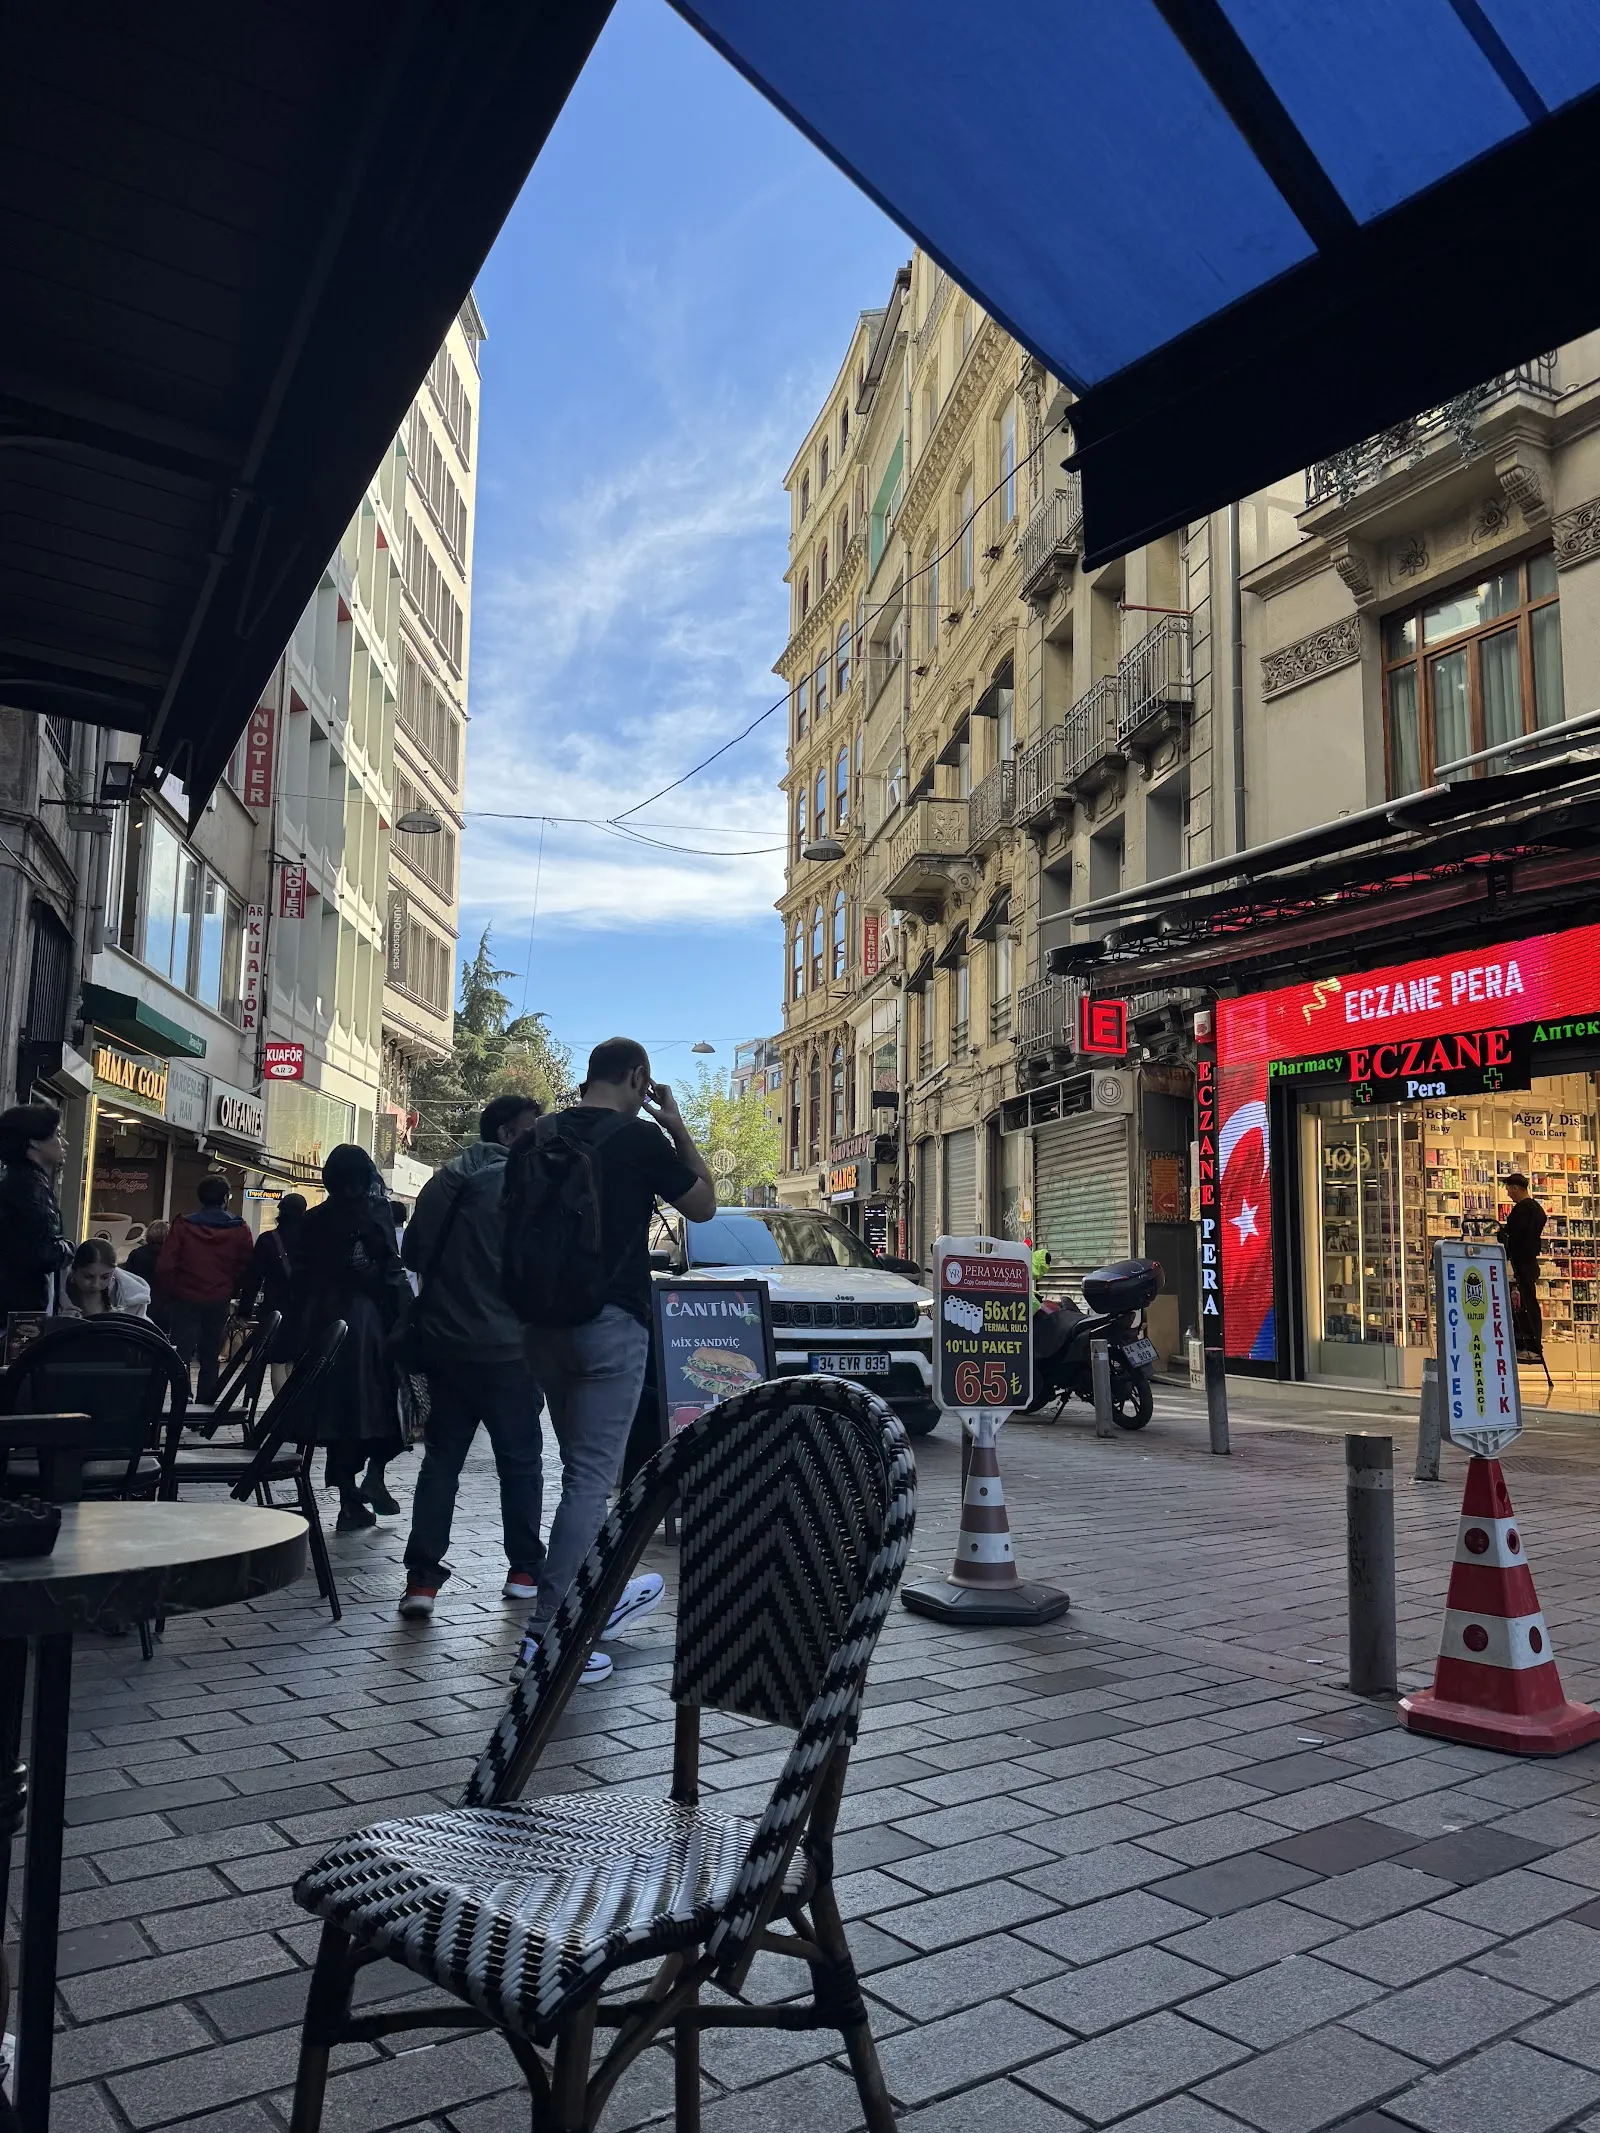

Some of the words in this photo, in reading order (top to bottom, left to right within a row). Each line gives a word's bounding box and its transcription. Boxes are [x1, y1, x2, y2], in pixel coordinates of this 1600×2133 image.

[250, 713, 268, 803] NOTER
[286, 867, 301, 917] NOTER
[248, 906, 263, 917] AR
[243, 922, 261, 1028] KUAFÖR
[1343, 976, 1442, 1022] ECZANE
[1451, 959, 1525, 1006] PERA
[266, 1047, 303, 1062] KUAFÖR
[1348, 1029, 1512, 1082] ECZANE
[275, 1066, 286, 1074] AR
[1268, 1055, 1343, 1079] Pharmacy
[1407, 1079, 1447, 1099] Pera
[1425, 1108, 1467, 1121] Bebek
[1514, 1112, 1543, 1124] Ağız
[1198, 1061, 1214, 1205] ECZANE
[1529, 1128, 1546, 1136] Oral
[1549, 1130, 1567, 1138] Care
[830, 1164, 857, 1192] CHANGE
[964, 1264, 990, 1277] PERA
[992, 1266, 1023, 1281] YAŞAR
[1202, 1218, 1219, 1315] PERA
[665, 1300, 754, 1317] CANTİNE
[984, 1300, 1026, 1321] 56x12
[984, 1322, 1010, 1333] TERMAL
[1010, 1323, 1028, 1333] RULO
[671, 1336, 691, 1348] MİX
[694, 1336, 740, 1349] SANDVİÇ
[945, 1339, 978, 1353] 10'LU
[982, 1340, 1023, 1354] PAKET
[1447, 1263, 1463, 1419] ERCİYES
[1490, 1265, 1511, 1414] ELEKTRİK
[819, 1357, 834, 1370] 34
[840, 1356, 860, 1371] EYR
[865, 1356, 886, 1371] 835
[1473, 1334, 1485, 1412] ANAHTARCI
[955, 1360, 1008, 1405] 65
